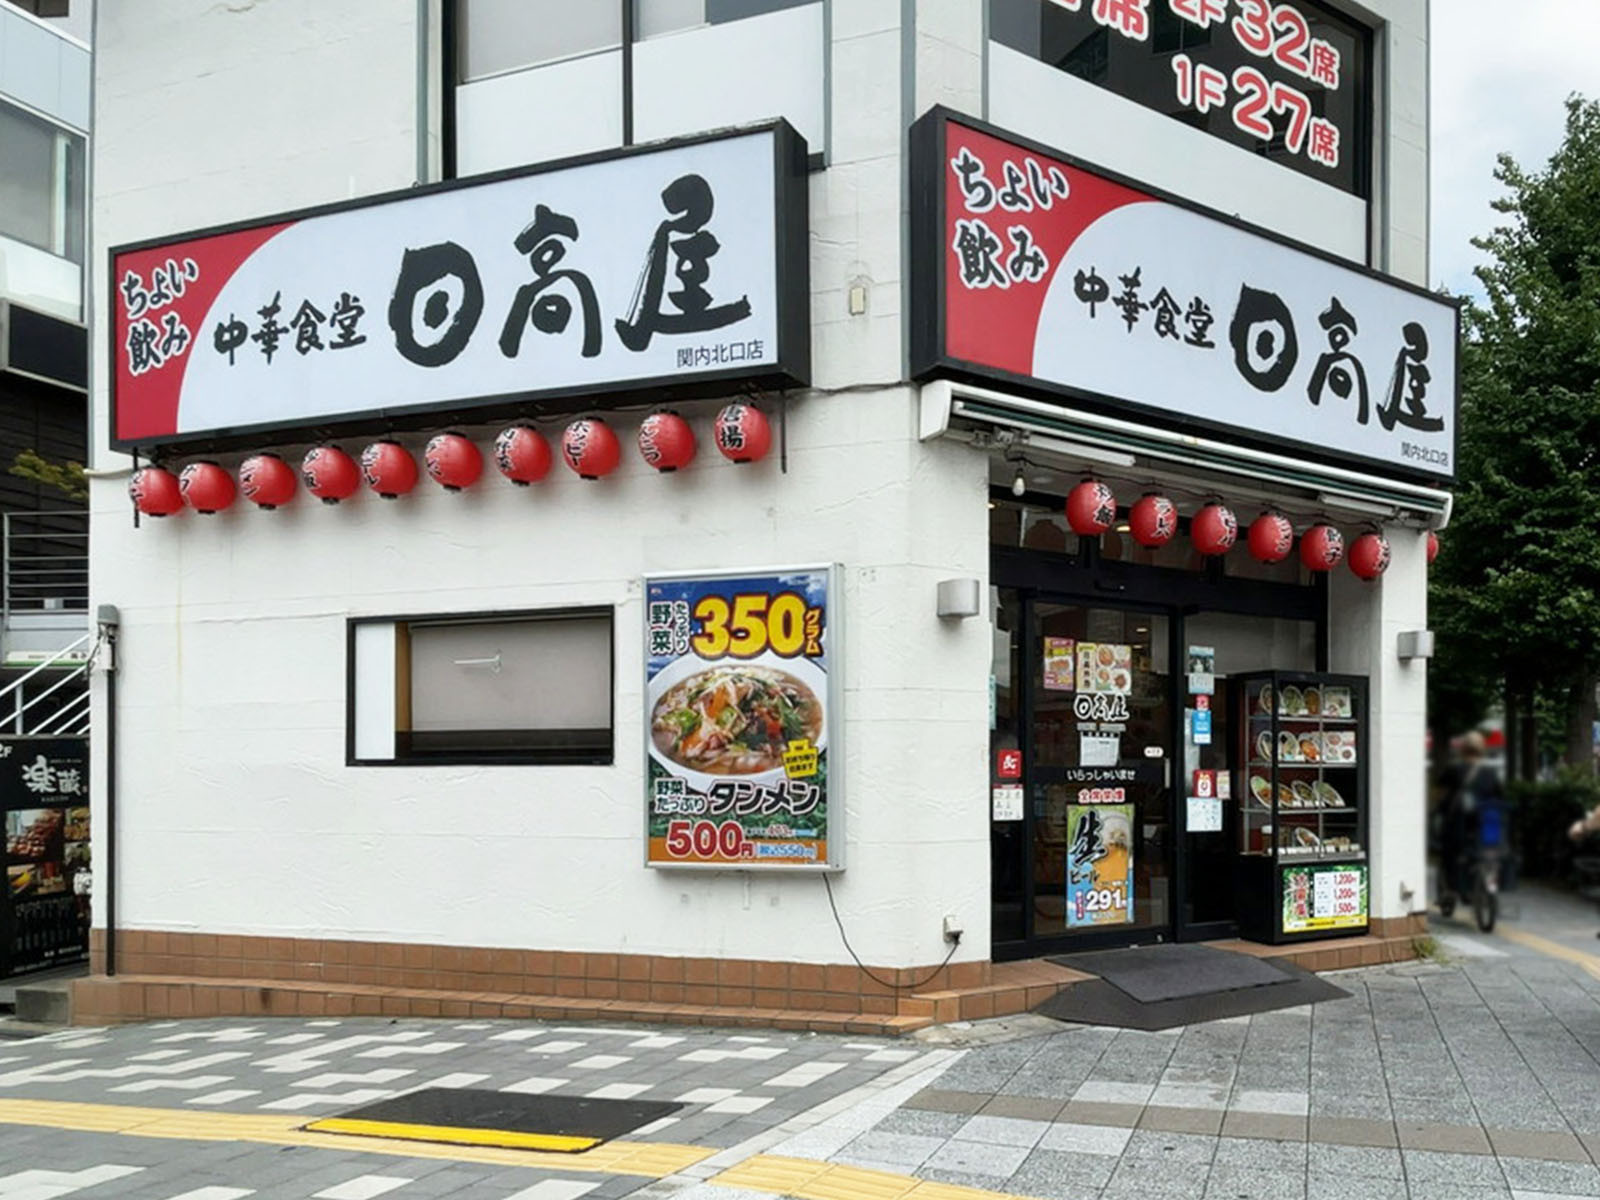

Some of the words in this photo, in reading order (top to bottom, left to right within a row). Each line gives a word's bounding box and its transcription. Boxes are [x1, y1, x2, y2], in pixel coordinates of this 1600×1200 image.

[951, 147, 1070, 213] ちょい
[212, 289, 368, 367] 中華食堂
[387, 173, 752, 368] 日高屋
[953, 219, 1048, 289] 飲み
[120, 258, 199, 318] ちょい
[126, 311, 192, 377] 飲み
[677, 339, 764, 369] 関内北口店
[1073, 265, 1216, 350] 中華食堂
[1228, 281, 1445, 432] 日高屋
[1401, 441, 1450, 467] 関内北口店
[651, 602, 674, 655] 野菜
[674, 600, 690, 654] たっぷり
[690, 592, 807, 660] 350
[804, 607, 824, 657] グラム
[1073, 692, 1131, 722] 日高屋
[654, 779, 687, 797] 野菜
[708, 779, 821, 815] タンメン
[1066, 769, 1137, 781] いらっしゃいませ
[654, 796, 707, 814] たっぷり
[667, 820, 756, 859] 500円
